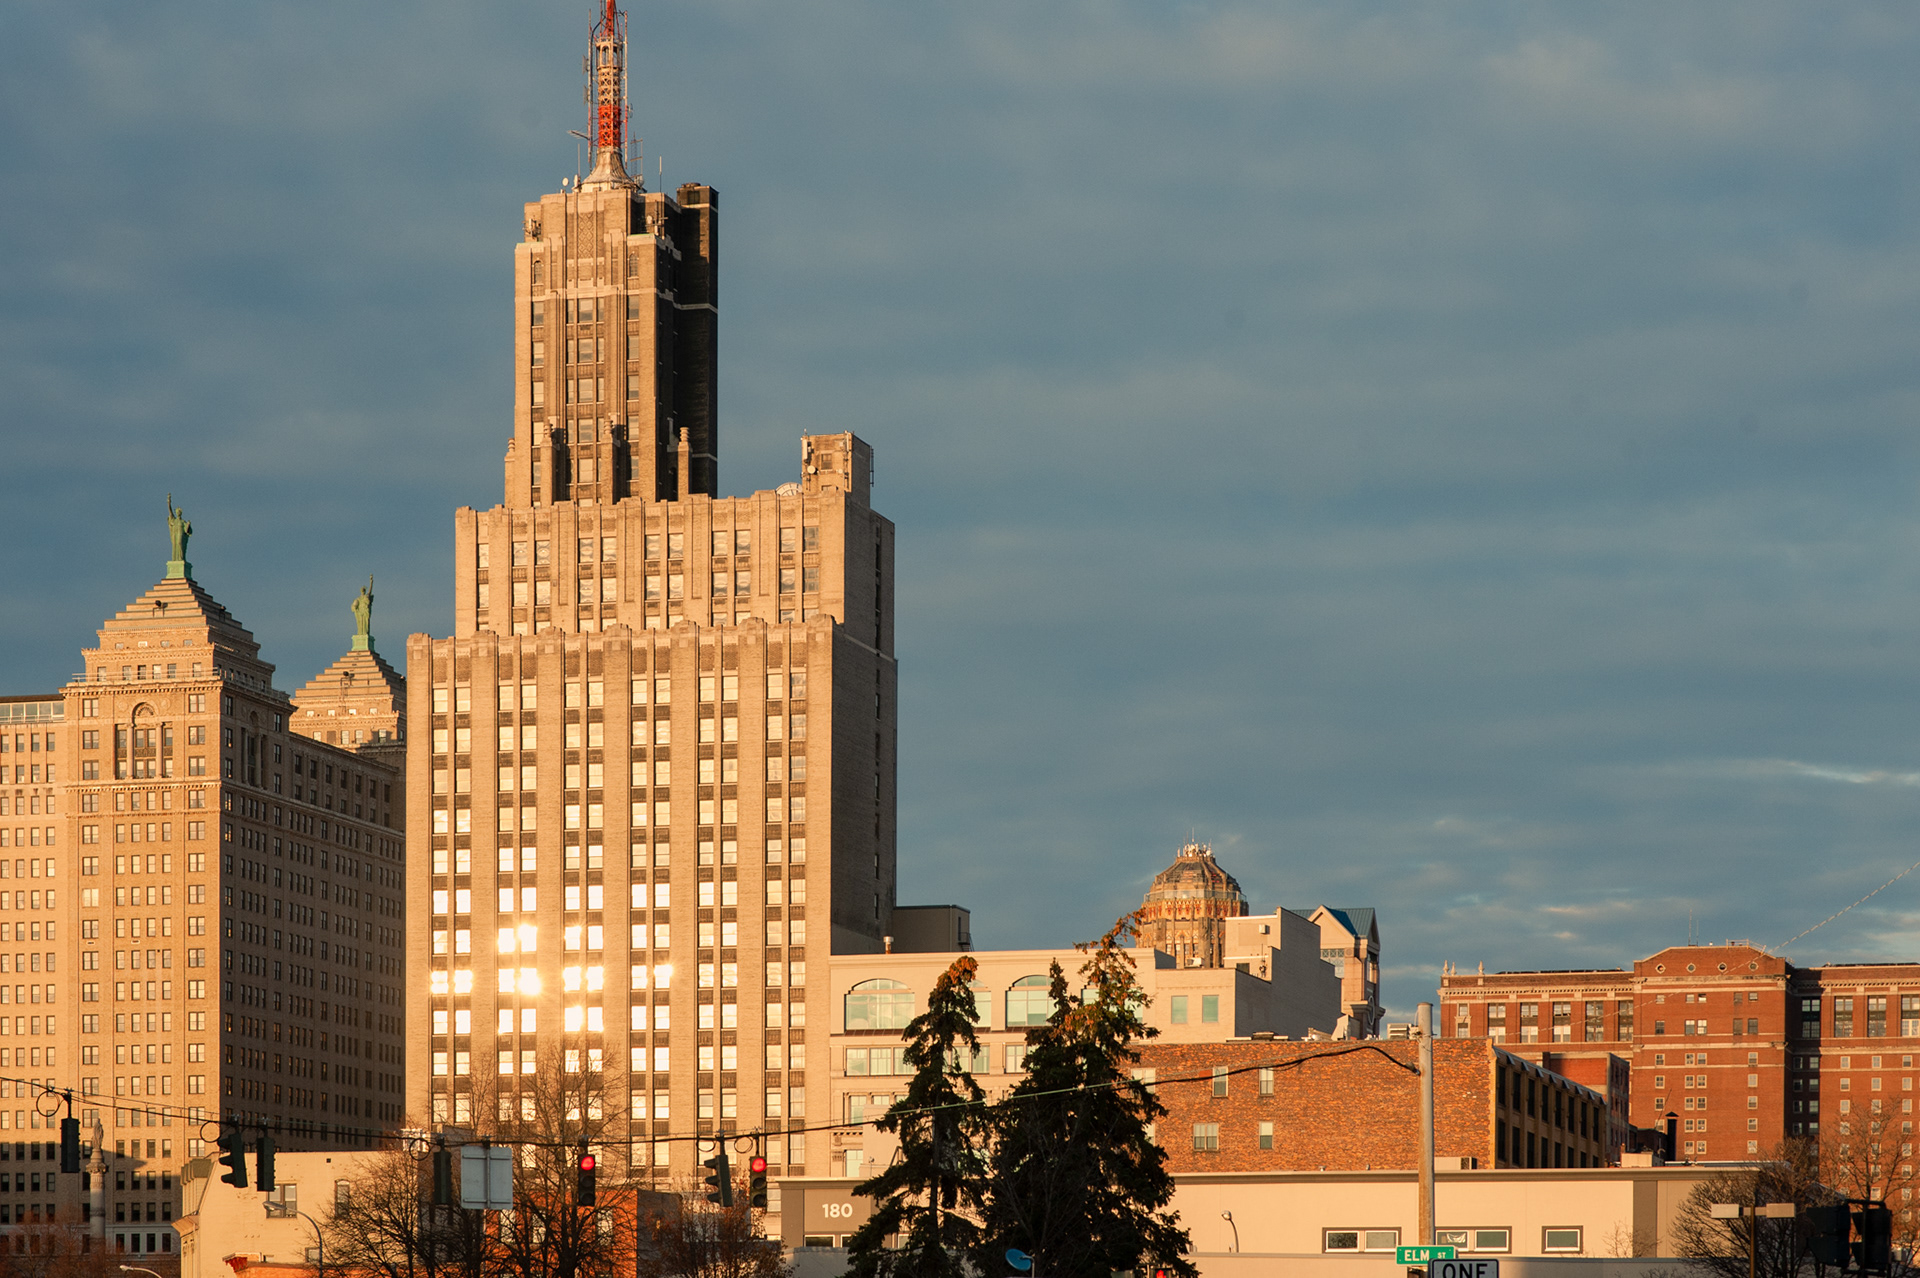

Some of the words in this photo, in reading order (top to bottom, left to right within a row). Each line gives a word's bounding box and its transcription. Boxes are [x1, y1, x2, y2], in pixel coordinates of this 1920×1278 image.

[822, 1203, 852, 1218] 180
[1404, 1249, 1430, 1262] ELM
[1442, 1263, 1488, 1278] ONE
